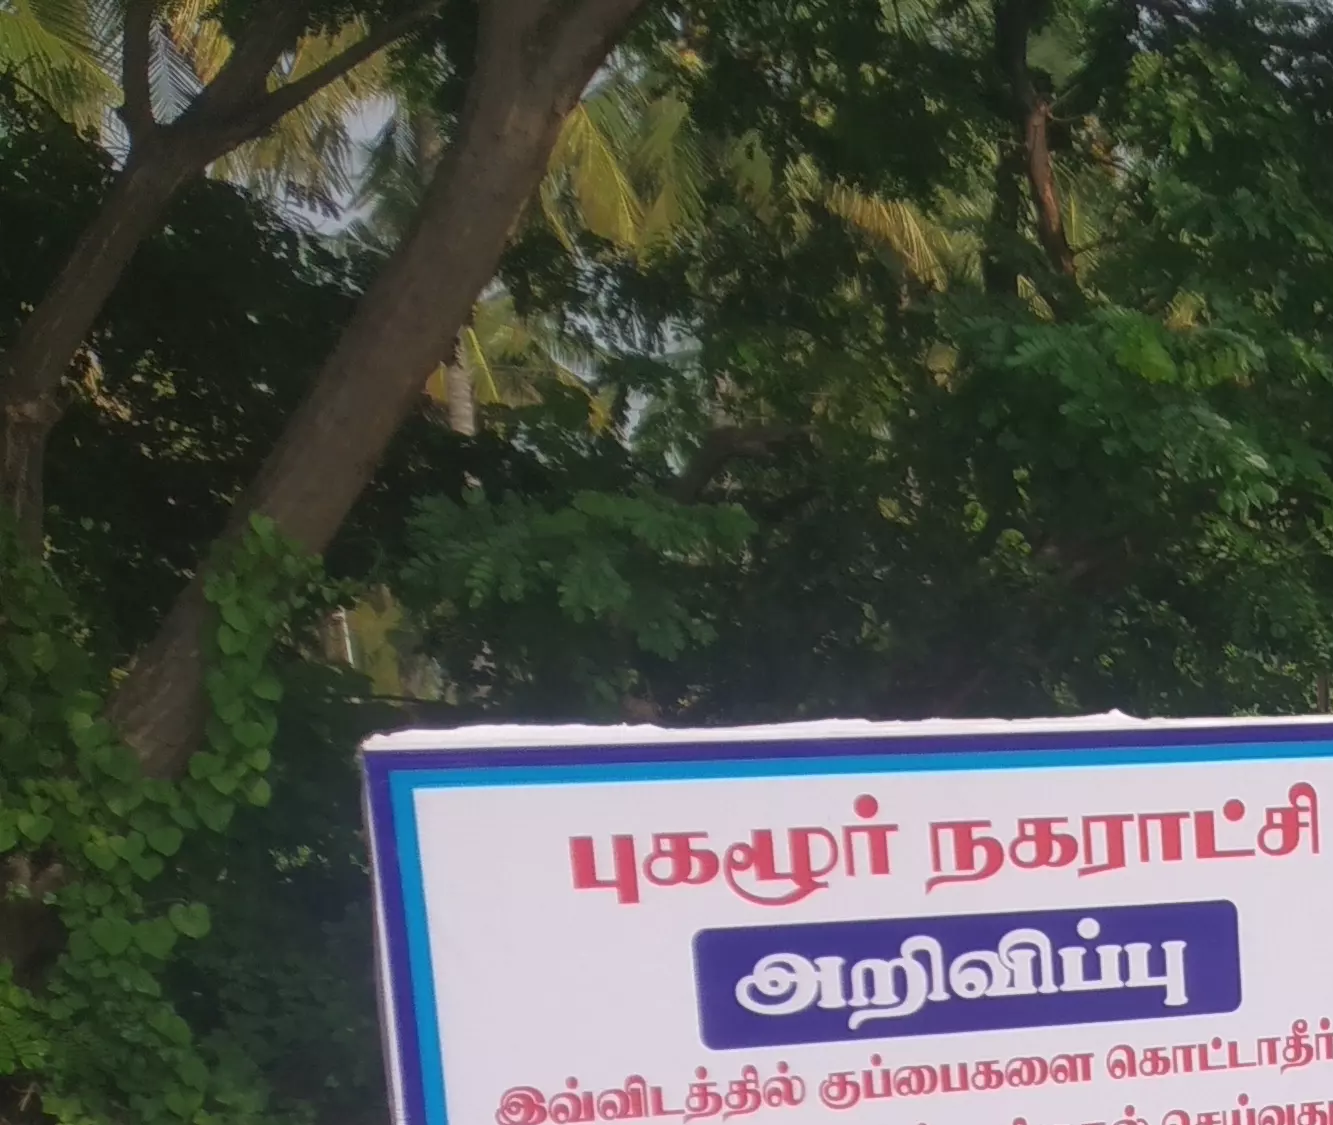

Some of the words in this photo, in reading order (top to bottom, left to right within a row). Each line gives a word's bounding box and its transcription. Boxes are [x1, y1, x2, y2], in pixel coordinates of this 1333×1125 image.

[568, 794, 899, 907] புகழூர்
[925, 781, 1321, 894] நகராட்சி
[734, 917, 1188, 1029] அறிவிப்பு
[818, 1052, 1095, 1111] குப்பைகளை
